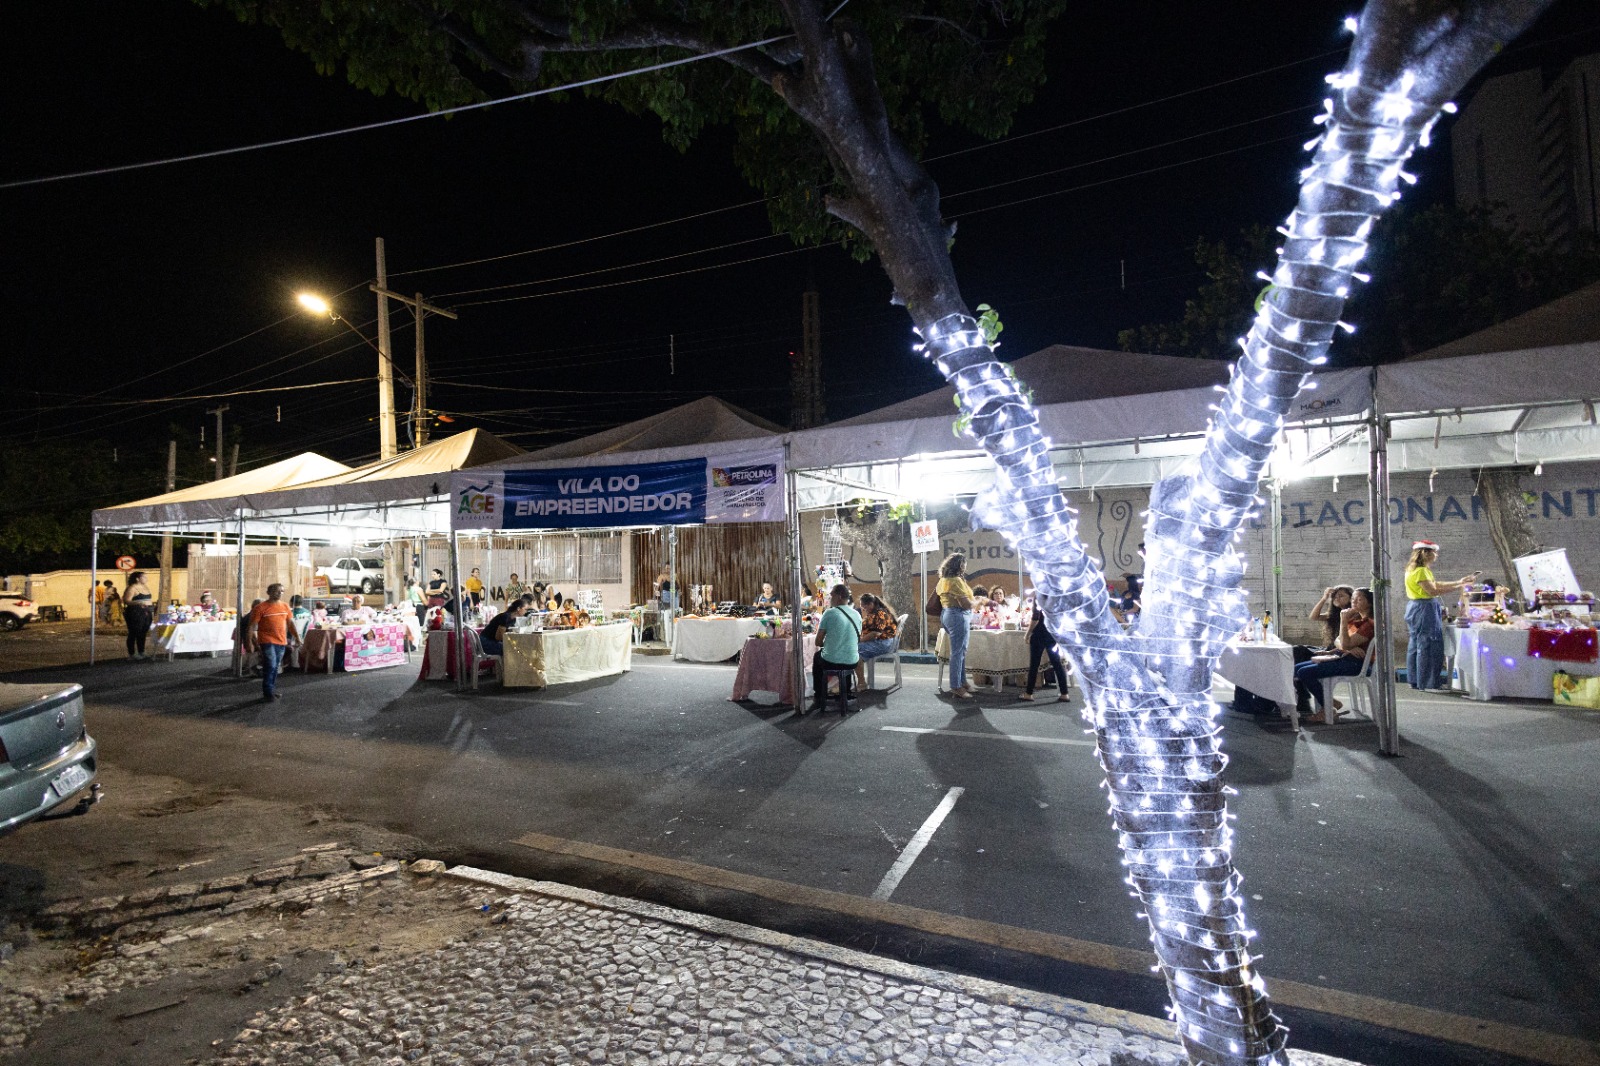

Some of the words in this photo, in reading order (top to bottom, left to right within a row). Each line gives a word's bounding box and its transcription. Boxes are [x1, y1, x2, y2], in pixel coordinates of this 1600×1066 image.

[557, 477, 605, 495] VILA
[608, 474, 640, 492] DO
[731, 469, 773, 481] PETROLINA
[458, 494, 495, 515] AGE
[515, 493, 692, 517] EMPREENDEDOR
